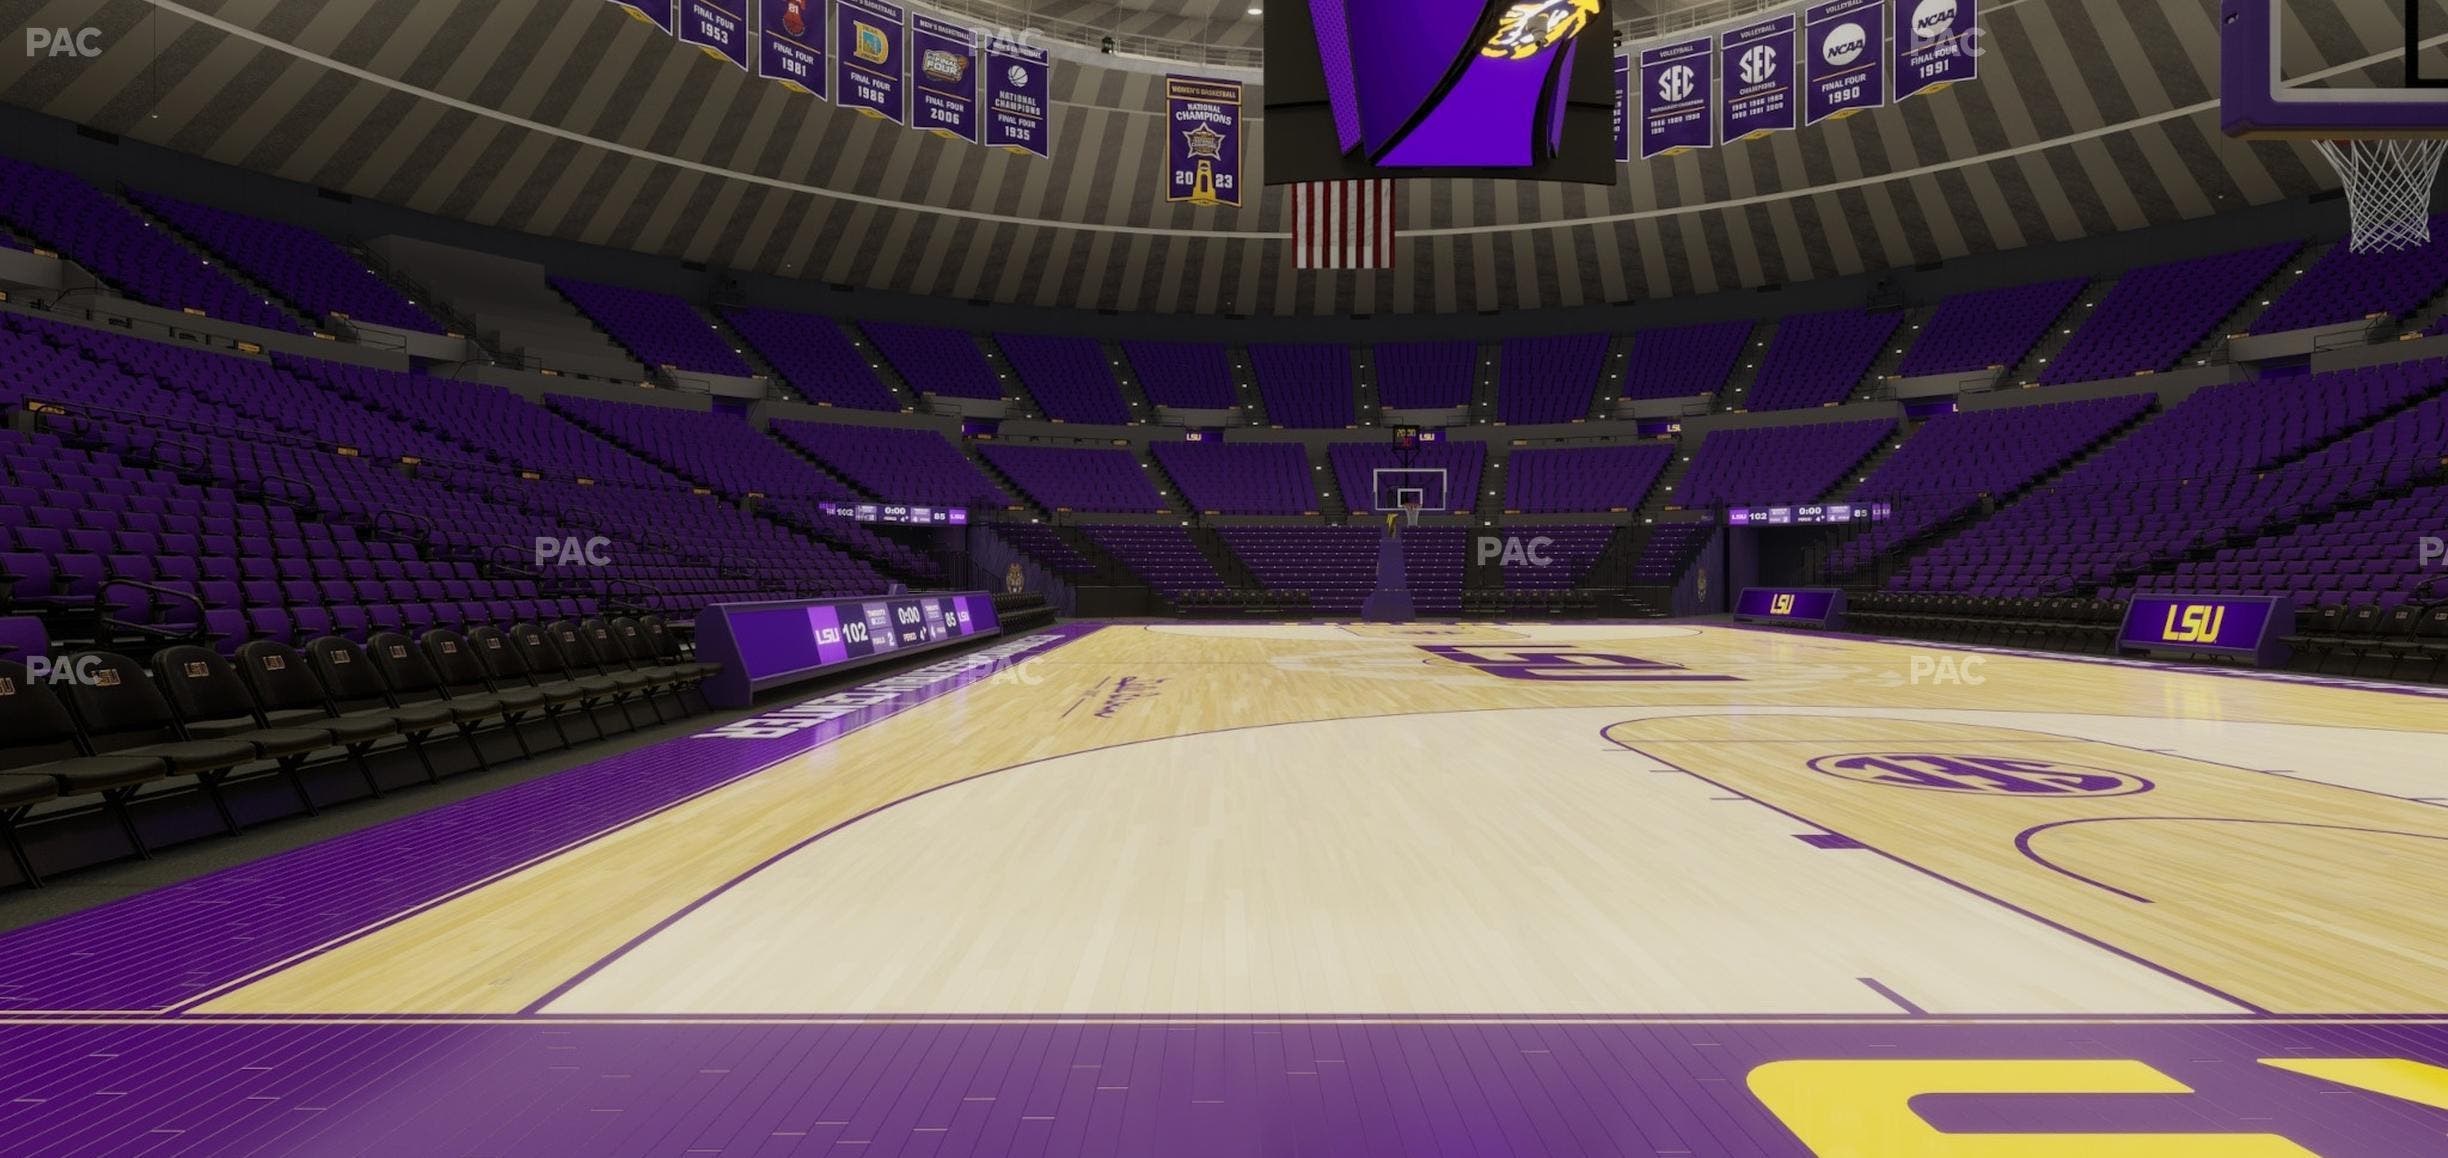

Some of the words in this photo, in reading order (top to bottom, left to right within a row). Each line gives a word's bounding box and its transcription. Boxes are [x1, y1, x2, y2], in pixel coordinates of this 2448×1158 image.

[1825, 0, 1863, 14] VOLLEYBALL
[693, 4, 714, 21] FINAL
[715, 15, 735, 31] FOUR
[1917, 8, 1955, 29] NCAA
[700, 21, 729, 44] 1953
[1740, 24, 1776, 39] VOLLEYBALL
[773, 42, 794, 56] FINAL
[795, 51, 814, 64] FOUR
[1660, 45, 1694, 58] VOLLEYBALL
[1827, 38, 1865, 58] NCAA
[1910, 54, 1933, 67] FINAL
[1934, 44, 1958, 58] FOUR
[781, 57, 807, 77] 1981
[926, 61, 958, 75] FOUR
[1738, 44, 1777, 84] SEC
[1919, 59, 1950, 80] 1991
[850, 72, 870, 85] FINAL
[872, 79, 891, 91] FOUR
[1658, 65, 1695, 102] SEC
[1821, 81, 1844, 93] FINAL
[1844, 73, 1866, 86] FOUR
[857, 86, 885, 104] 1986
[999, 90, 1036, 105] NATIONAL
[1172, 85, 1200, 95] WOMEN'S
[1201, 88, 1236, 98] BASKETBALL
[1828, 86, 1861, 105] 1990
[925, 95, 944, 107] FINAL
[945, 100, 964, 112] FOUR
[995, 98, 1040, 115] CHAMPIONS
[1187, 103, 1221, 113] NATIONAL
[930, 107, 960, 124] 2006
[998, 114, 1017, 125] FINAL
[1018, 119, 1036, 128] FOUR
[1175, 111, 1232, 126] CHAMPIONS
[1004, 126, 1031, 140] 1935
[1175, 170, 1194, 185] 20
[1215, 173, 1233, 188] 23
[885, 507, 906, 515] 0:00
[934, 512, 946, 520] 85
[1749, 512, 1767, 520] 102
[1799, 507, 1822, 515] 0:00
[1854, 509, 1868, 517] 85
[1769, 593, 1796, 615] LSU
[898, 606, 920, 625] 0:00
[945, 611, 957, 627] 85
[957, 611, 970, 622] LSU
[2162, 604, 2225, 643] LSU
[815, 627, 840, 645] LSU
[842, 622, 869, 643] 102
[887, 632, 895, 646] 2
